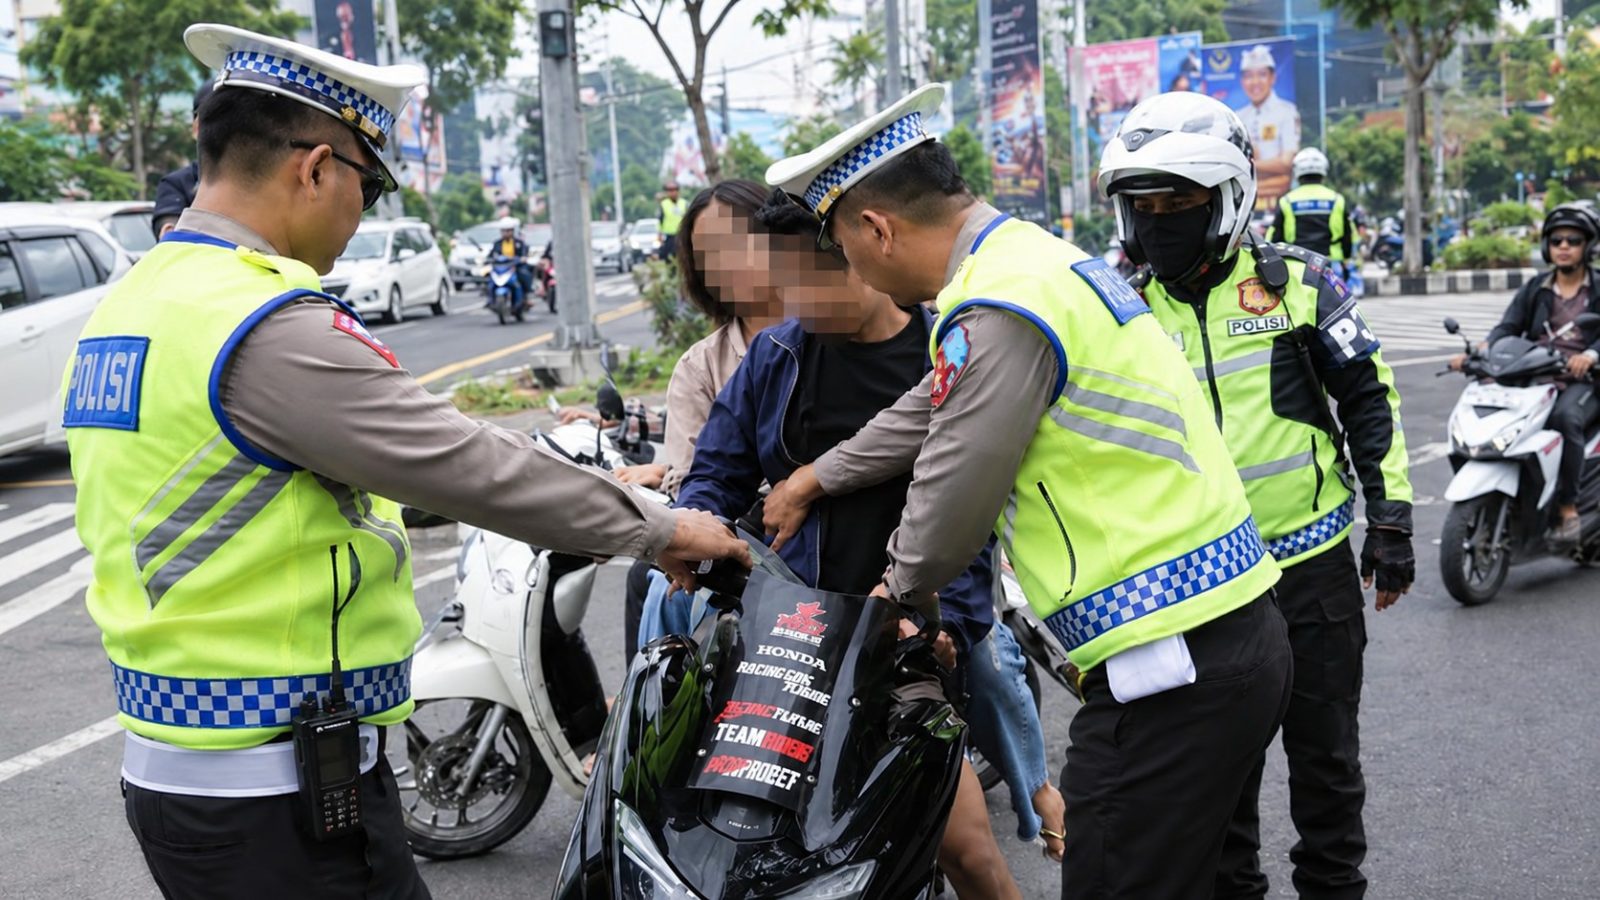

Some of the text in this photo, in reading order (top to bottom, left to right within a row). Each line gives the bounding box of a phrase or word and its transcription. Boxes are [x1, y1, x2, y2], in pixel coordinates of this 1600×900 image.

[1232, 317, 1285, 333] POLISI
[65, 351, 138, 412] POLISI
[736, 661, 786, 680] RACING
[756, 645, 827, 672] HONDA
[715, 722, 767, 748] TEAM
